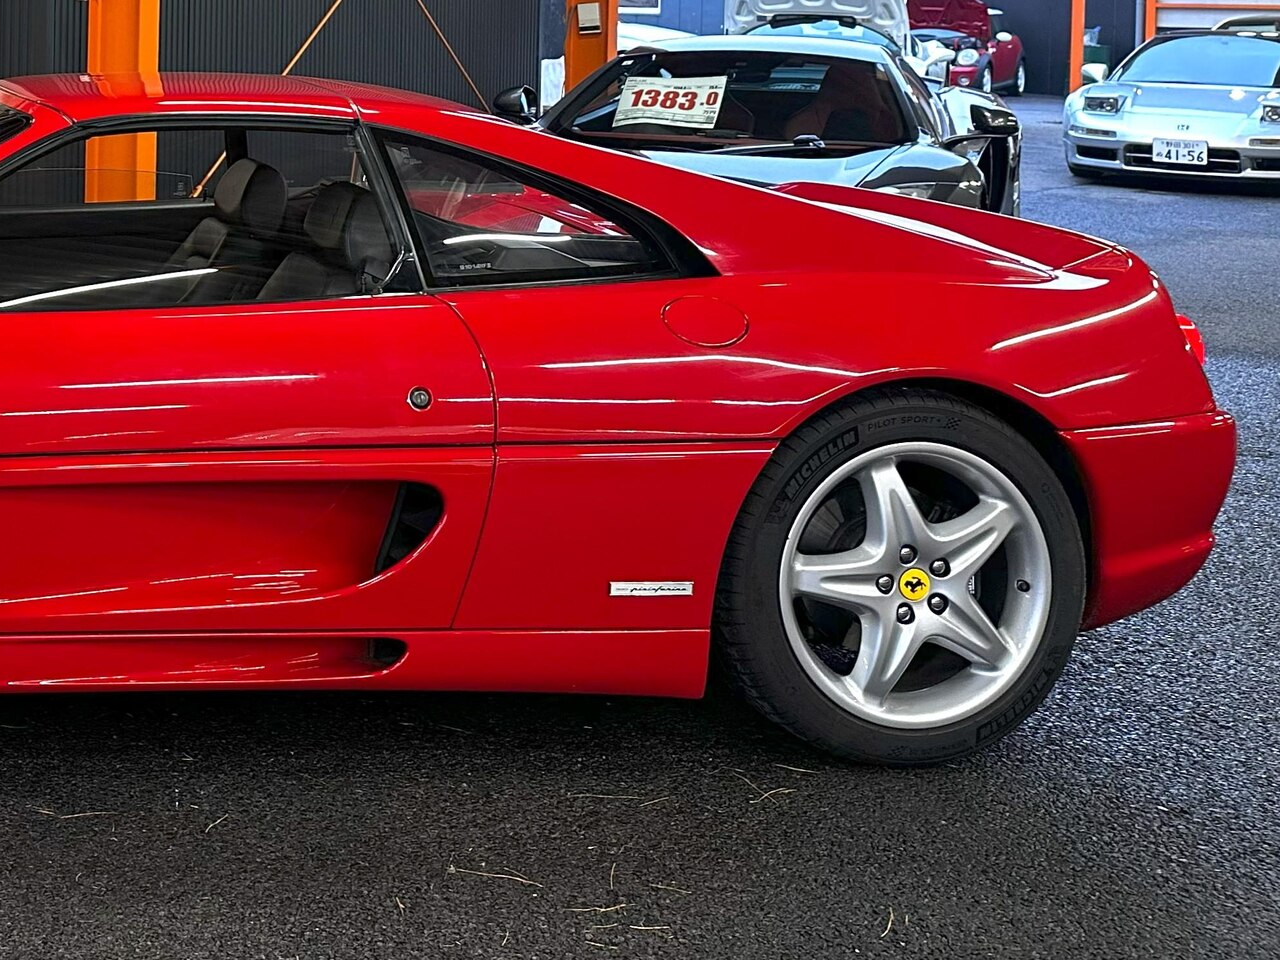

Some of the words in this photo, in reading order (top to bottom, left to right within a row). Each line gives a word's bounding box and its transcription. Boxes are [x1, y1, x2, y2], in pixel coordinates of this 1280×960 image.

[631, 88, 720, 111] 1383.0
[1165, 149, 1204, 162] 41-56
[867, 417, 898, 432] PILOT
[900, 415, 936, 424] SPORT
[785, 429, 857, 498] MICHELIN
